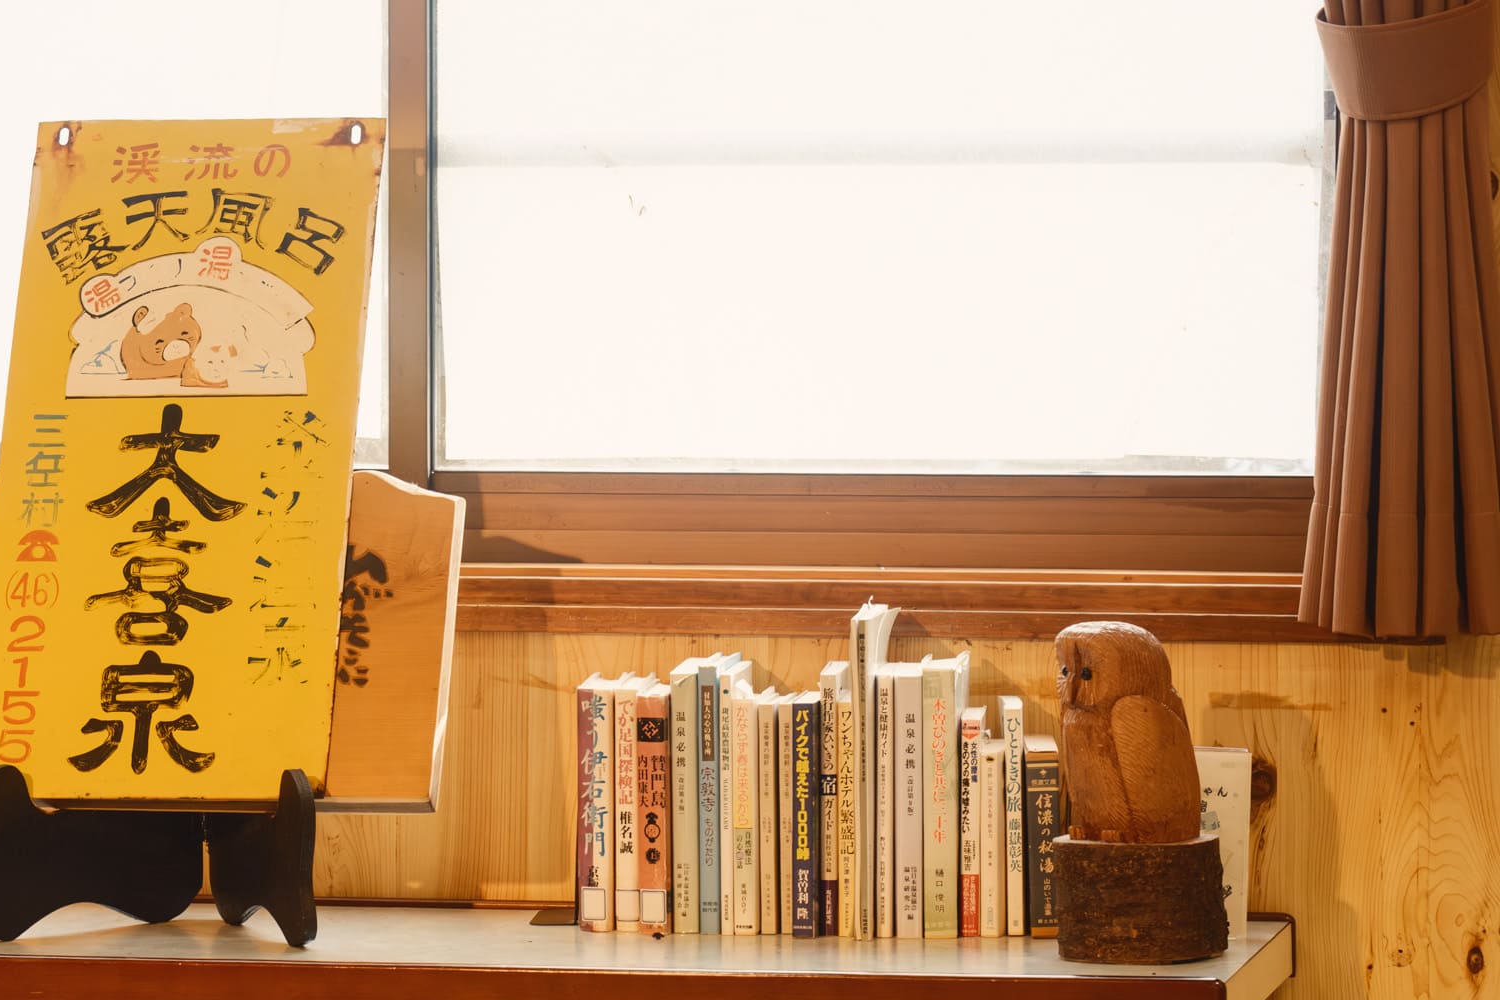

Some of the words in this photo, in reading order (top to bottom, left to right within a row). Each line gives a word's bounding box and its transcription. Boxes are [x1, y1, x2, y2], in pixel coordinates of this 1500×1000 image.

[41, 188, 346, 285] 露天風呂
[68, 403, 248, 775] 大喜泉
[580, 694, 608, 857] 嗤う伊右衛門
[675, 712, 687, 767] 温泉必携
[905, 713, 916, 769] 温泉必携
[1007, 717, 1022, 812] ひとときの旅
[638, 755, 649, 807] 内田康夫
[620, 811, 633, 854] 椎名誠
[1035, 793, 1054, 874] 信濃の秘湯
